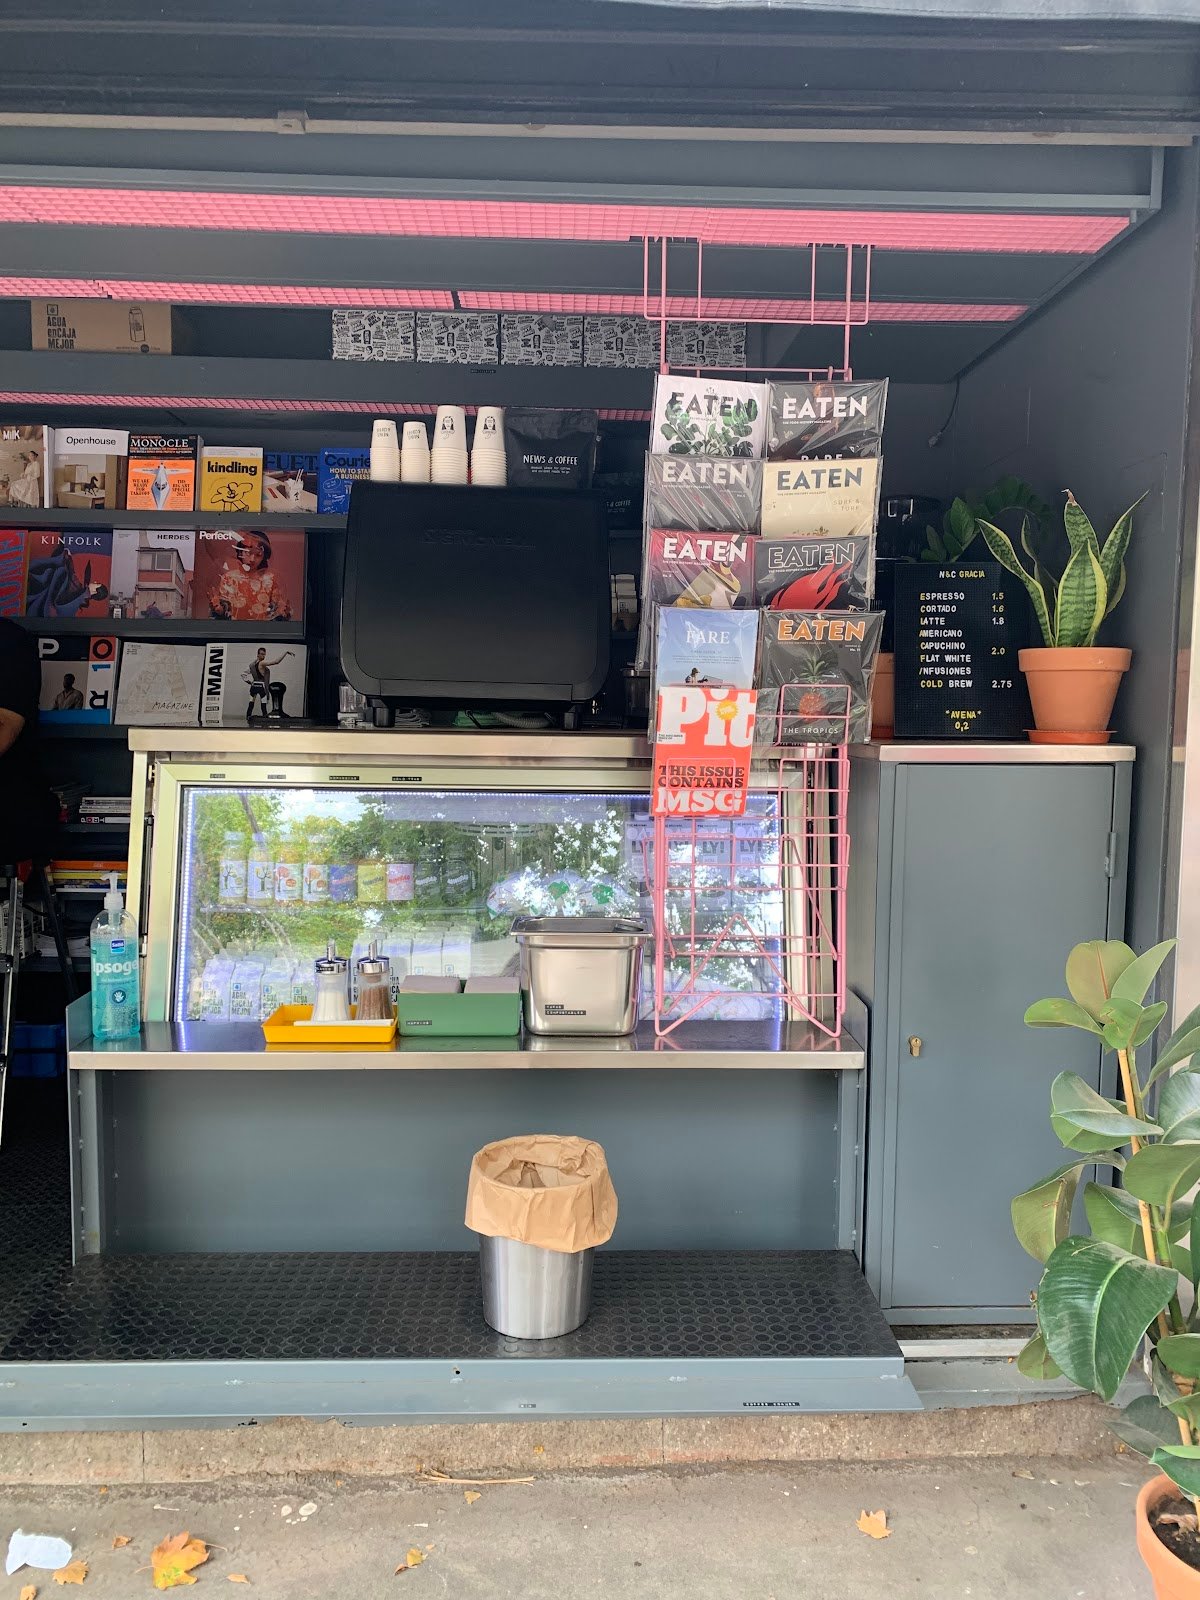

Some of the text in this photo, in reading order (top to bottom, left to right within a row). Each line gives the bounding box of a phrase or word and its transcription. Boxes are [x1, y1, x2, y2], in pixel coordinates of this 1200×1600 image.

[47, 317, 66, 327] AGUA
[48, 339, 74, 349] MEJOR
[669, 392, 757, 418] EATEN
[782, 396, 867, 419] EATEN
[66, 436, 116, 446] Openhouse
[130, 439, 188, 447] MONOCLE
[523, 455, 545, 463] NEWS
[555, 456, 578, 465] COFFEE
[207, 461, 258, 476] kindling
[663, 462, 747, 485] EATEN
[777, 467, 862, 490] EATEN
[41, 535, 101, 546] KINFOLK
[199, 531, 232, 540] Perfect
[663, 538, 747, 562] EATEN
[768, 543, 855, 568] EATEN
[920, 592, 965, 600] ESPRESSO
[778, 620, 866, 641] EATEN
[207, 648, 224, 695] MAN
[152, 701, 195, 710] MAGAZINE
[657, 686, 756, 747] Pit
[659, 765, 744, 777] THIS ISSUE
[658, 777, 744, 788] CONTAINS
[655, 787, 742, 812] MSG
